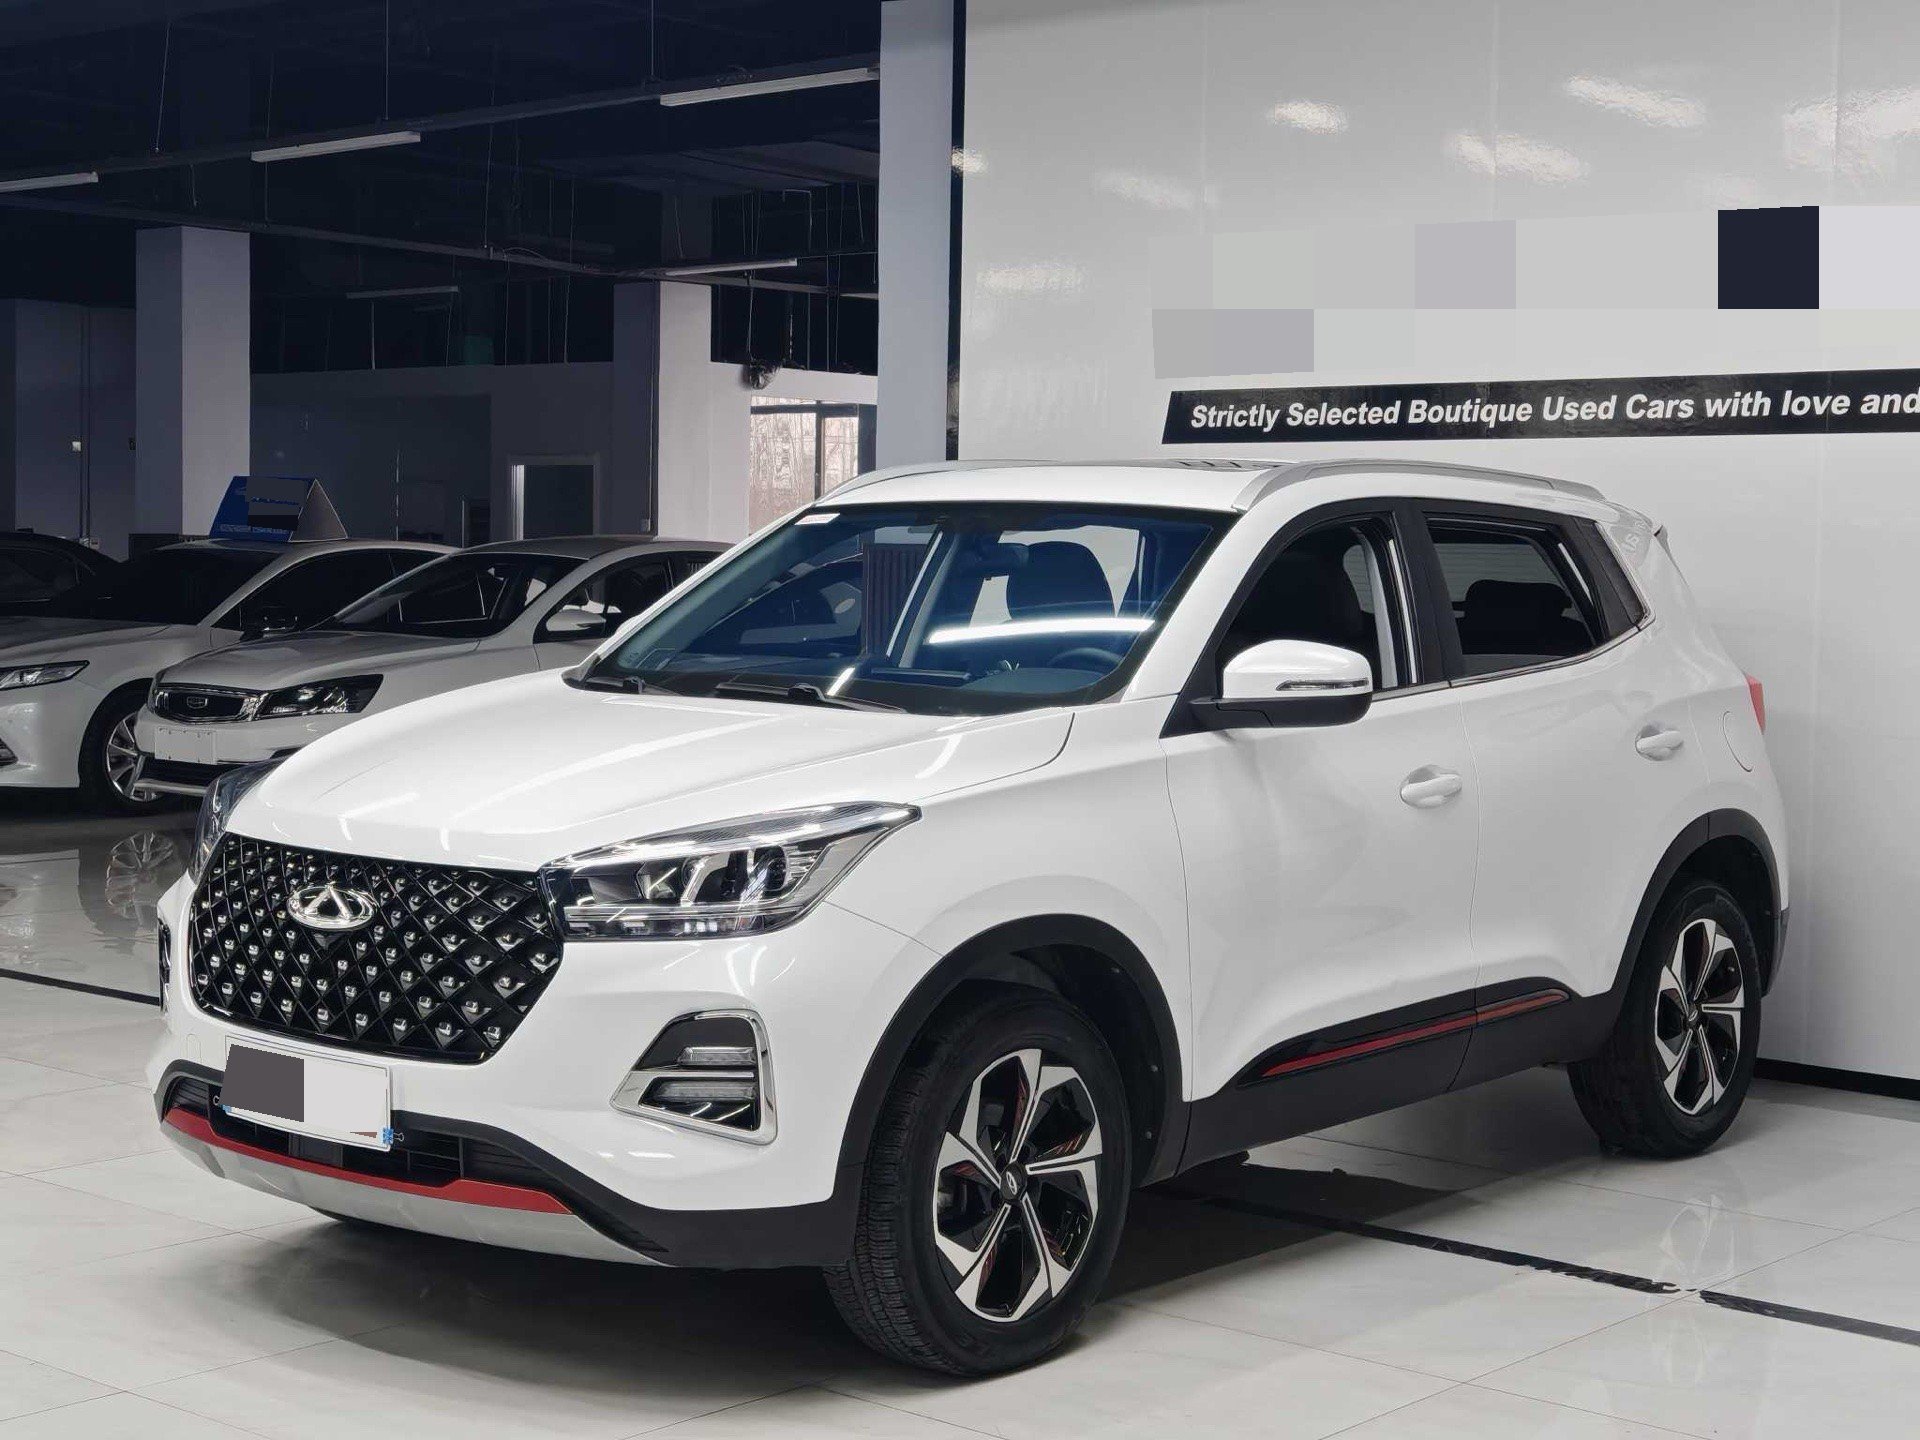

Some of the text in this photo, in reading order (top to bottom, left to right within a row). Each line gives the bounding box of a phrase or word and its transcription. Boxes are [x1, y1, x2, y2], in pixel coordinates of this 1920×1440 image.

[1190, 404, 1281, 433] Strictly
[1286, 401, 1400, 426] Selected
[1407, 397, 1533, 429] Boutique
[1542, 394, 1618, 422] Used
[1625, 394, 1695, 420] Cars
[1704, 391, 1772, 418] with
[1780, 389, 1851, 417] love
